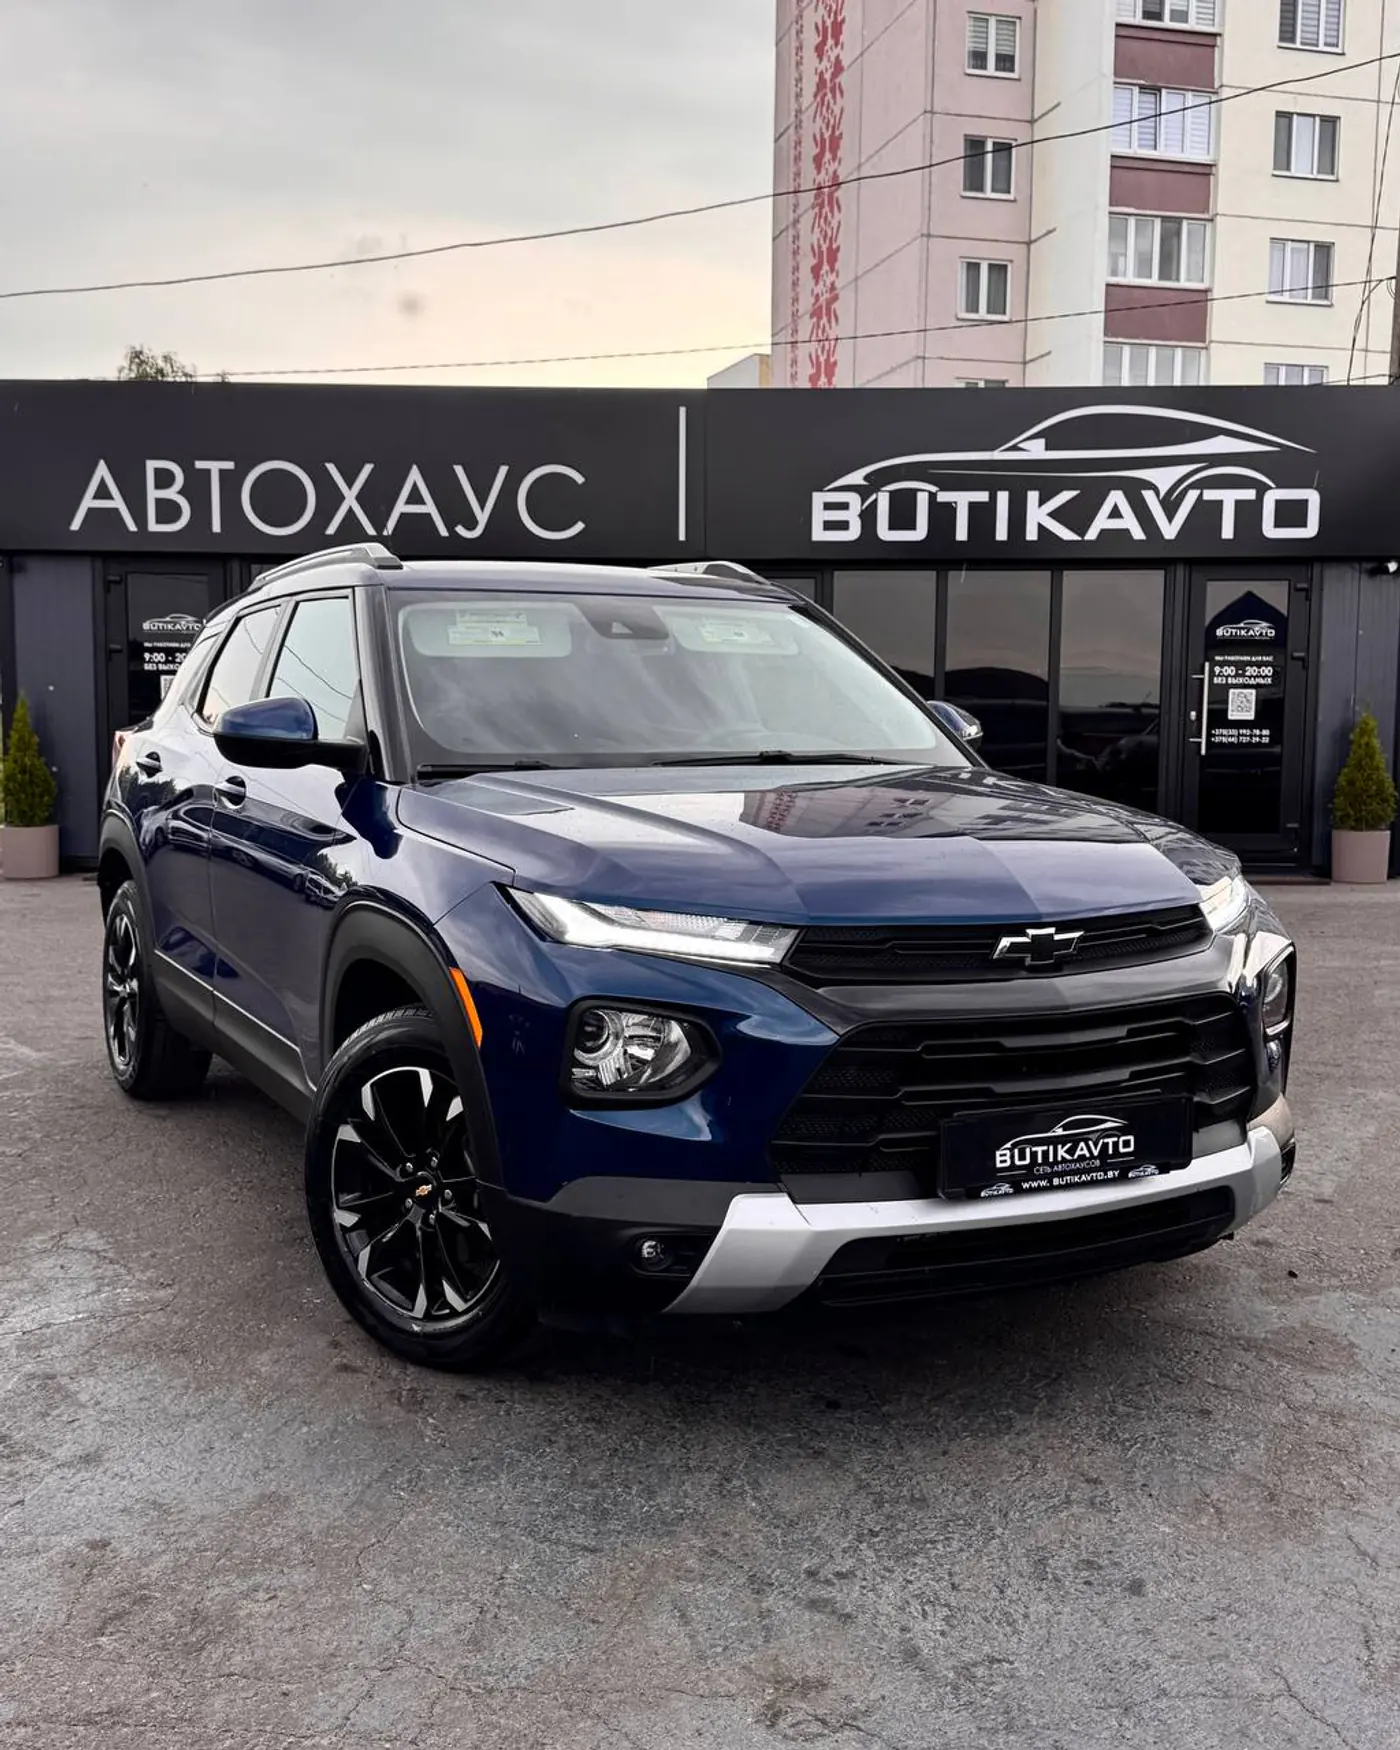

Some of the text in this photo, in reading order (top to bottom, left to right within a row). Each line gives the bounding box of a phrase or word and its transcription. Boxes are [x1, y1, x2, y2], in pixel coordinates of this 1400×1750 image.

[69, 458, 586, 541] АВТОХАУС
[811, 487, 1322, 543] BUTIKAVTO
[1215, 627, 1276, 637] BUTIKAVTO
[143, 652, 166, 662] 9:00
[143, 663, 157, 671] БЕЗ
[1213, 666, 1236, 676] 9:00
[1245, 666, 1273, 676] 20:00
[1213, 676, 1273, 684] БЕЗ ВЫХОДНЫХ
[995, 1135, 1134, 1168] BUTIKAVTO
[1053, 1159, 1101, 1172] АВТОХАУСОВ
[1021, 1170, 1120, 1189] WWW. BUTIKAVTO.BY
